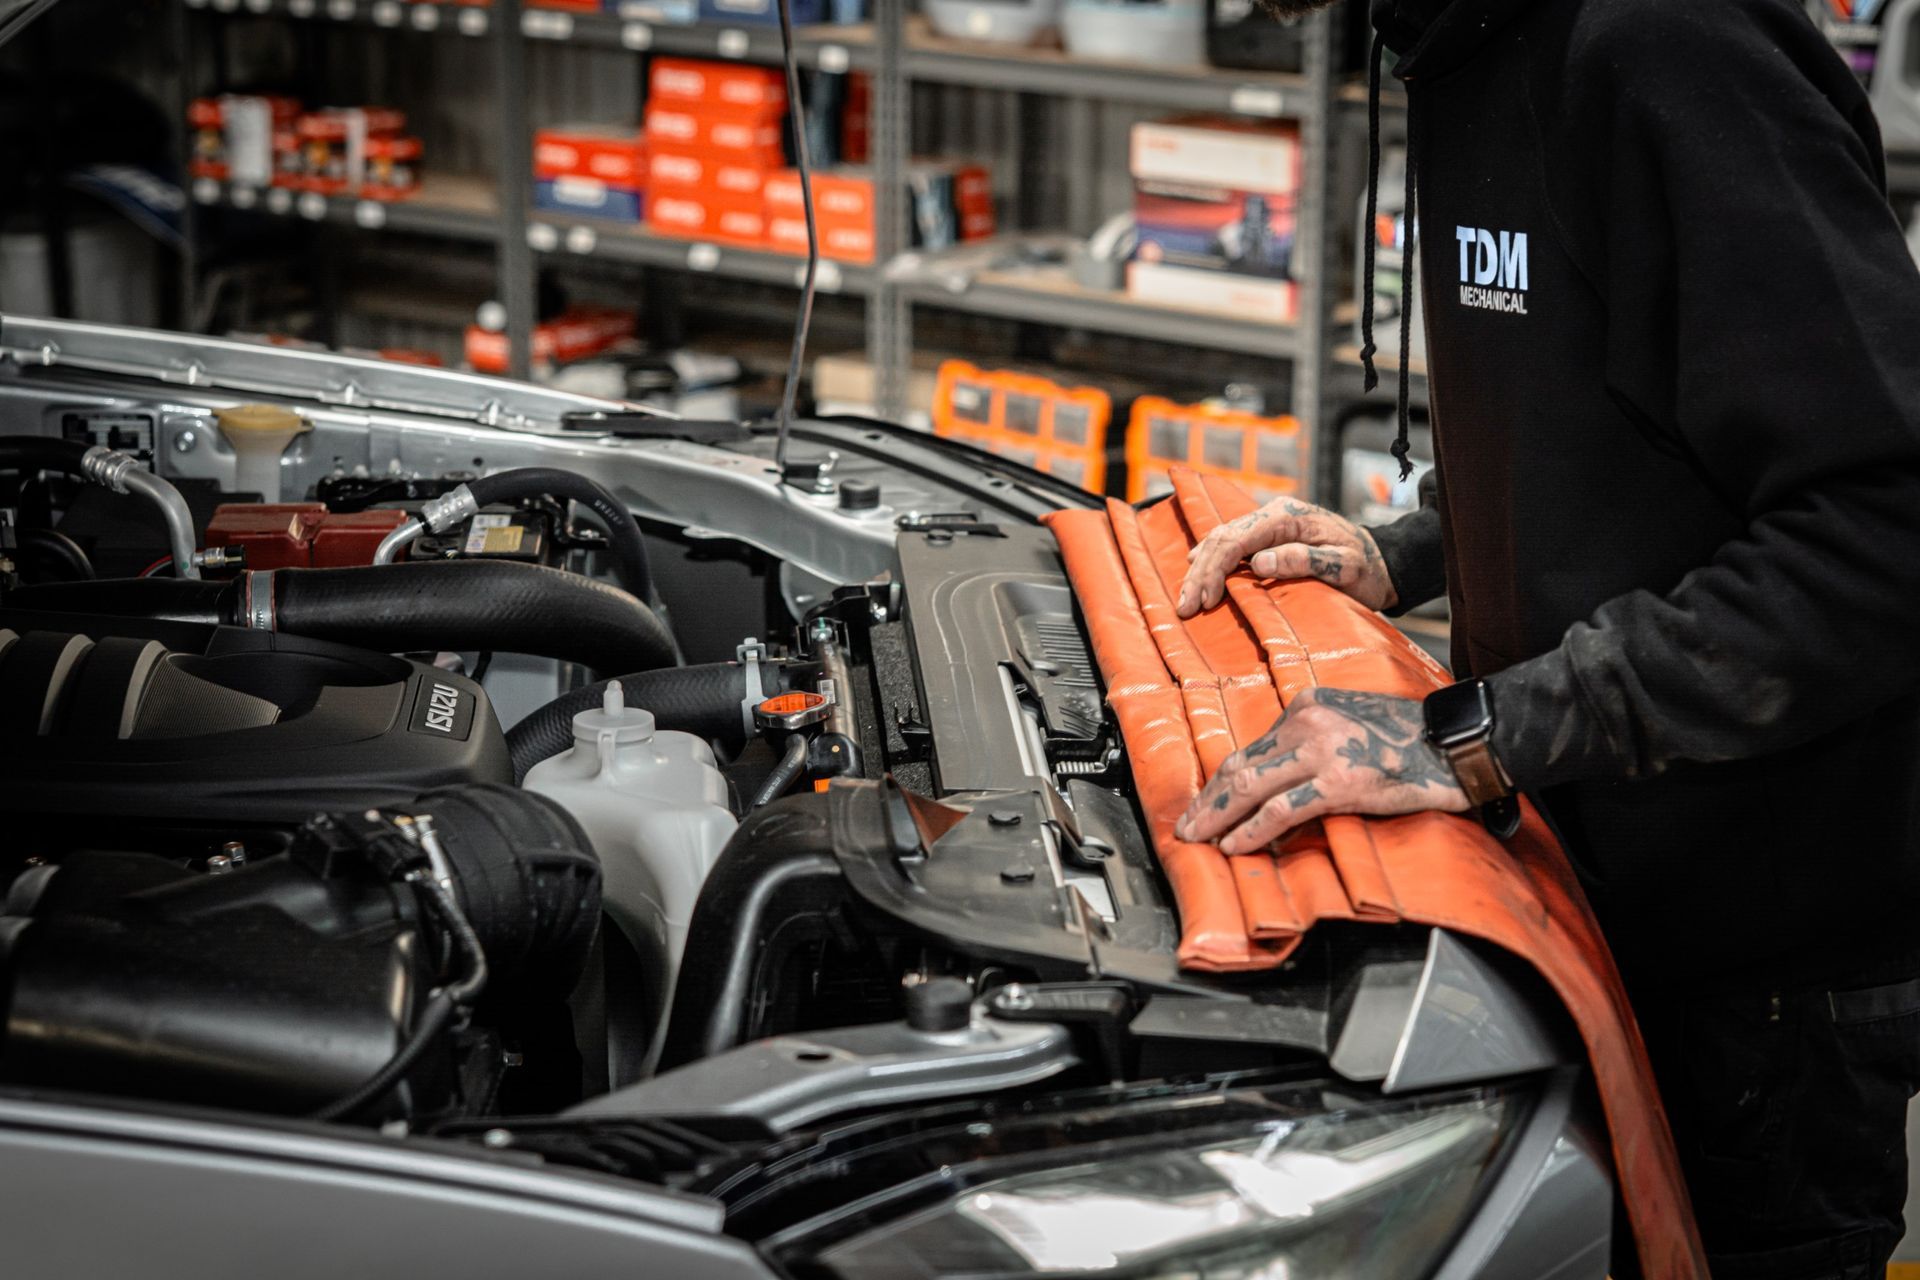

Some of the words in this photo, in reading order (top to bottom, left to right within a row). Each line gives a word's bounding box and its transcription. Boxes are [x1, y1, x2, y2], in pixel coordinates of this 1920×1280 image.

[1456, 225, 1528, 291] TDM
[1460, 285, 1528, 315] MECHANICAL
[425, 683, 459, 733] ISUZU
